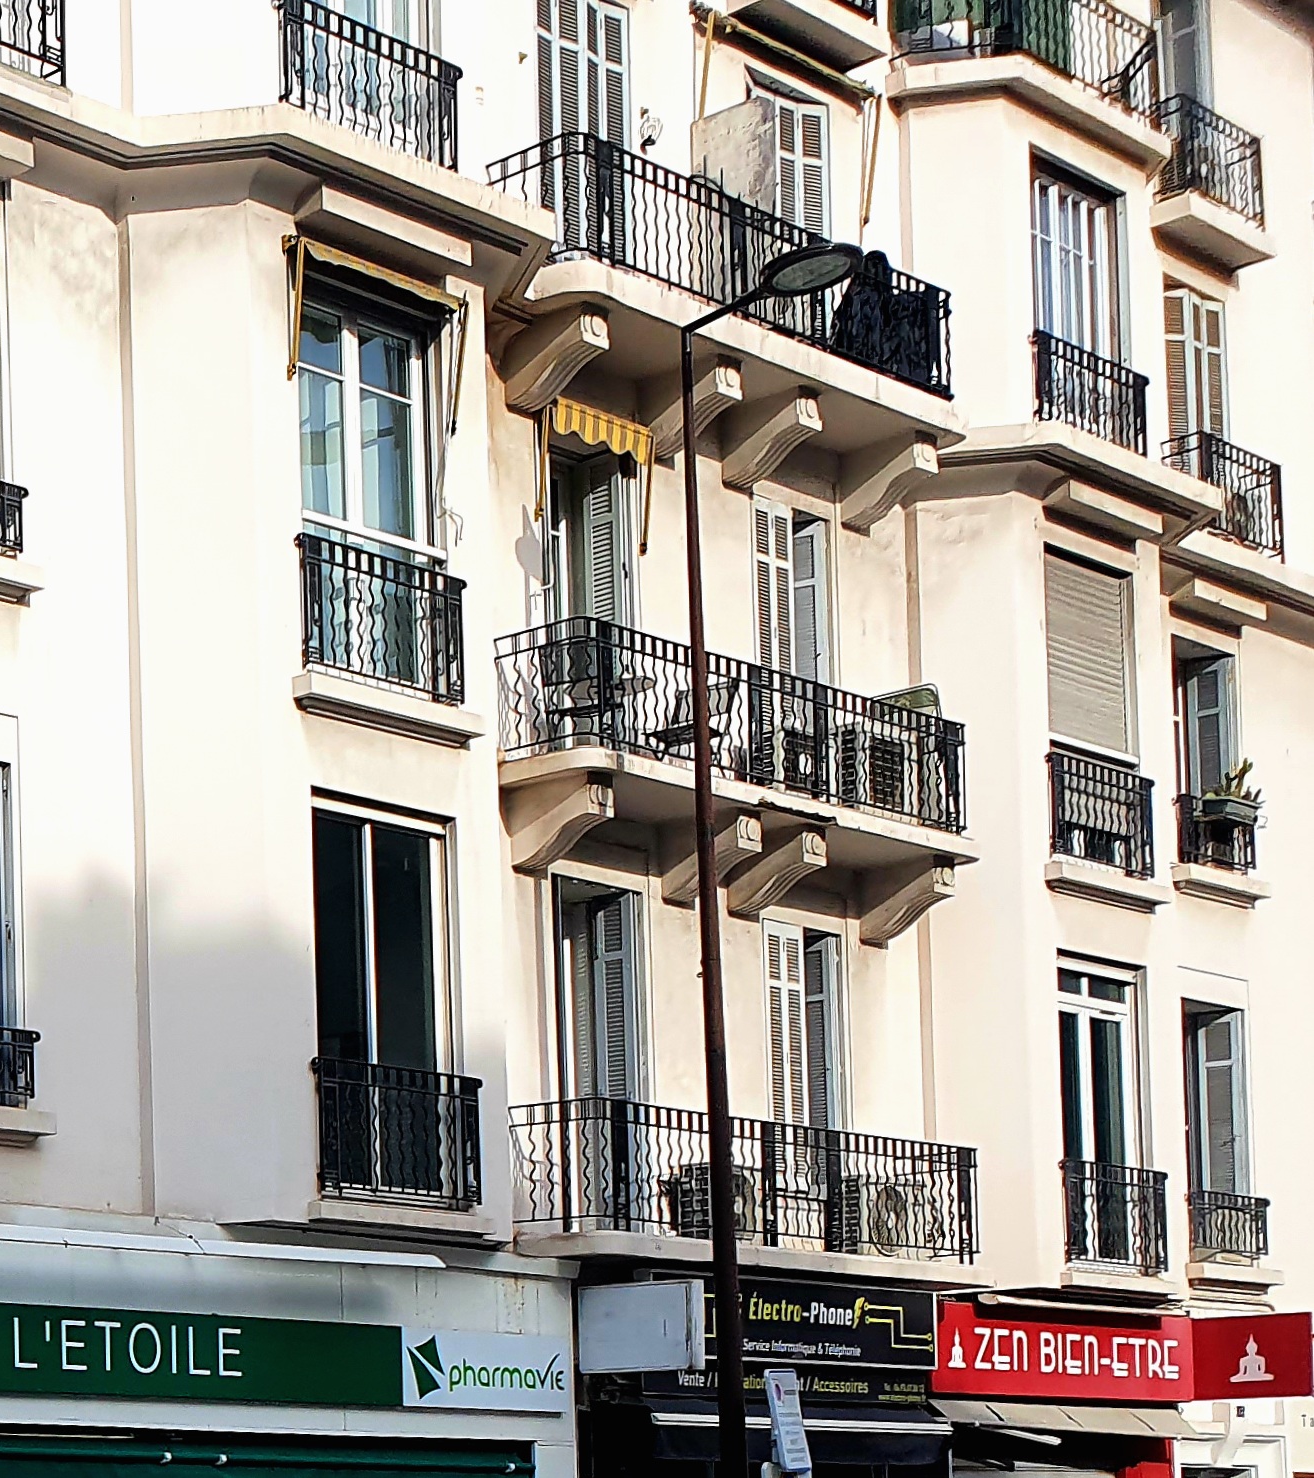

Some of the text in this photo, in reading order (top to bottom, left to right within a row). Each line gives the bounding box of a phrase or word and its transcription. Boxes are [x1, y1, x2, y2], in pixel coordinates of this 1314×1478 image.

[10, 1317, 243, 1380] L'ETOILE
[742, 1338, 771, 1351] Service
[974, 1326, 1179, 1380] ZEN BIEN-ETRE
[678, 1370, 705, 1387] Vente
[812, 1377, 869, 1394] Accessoires
